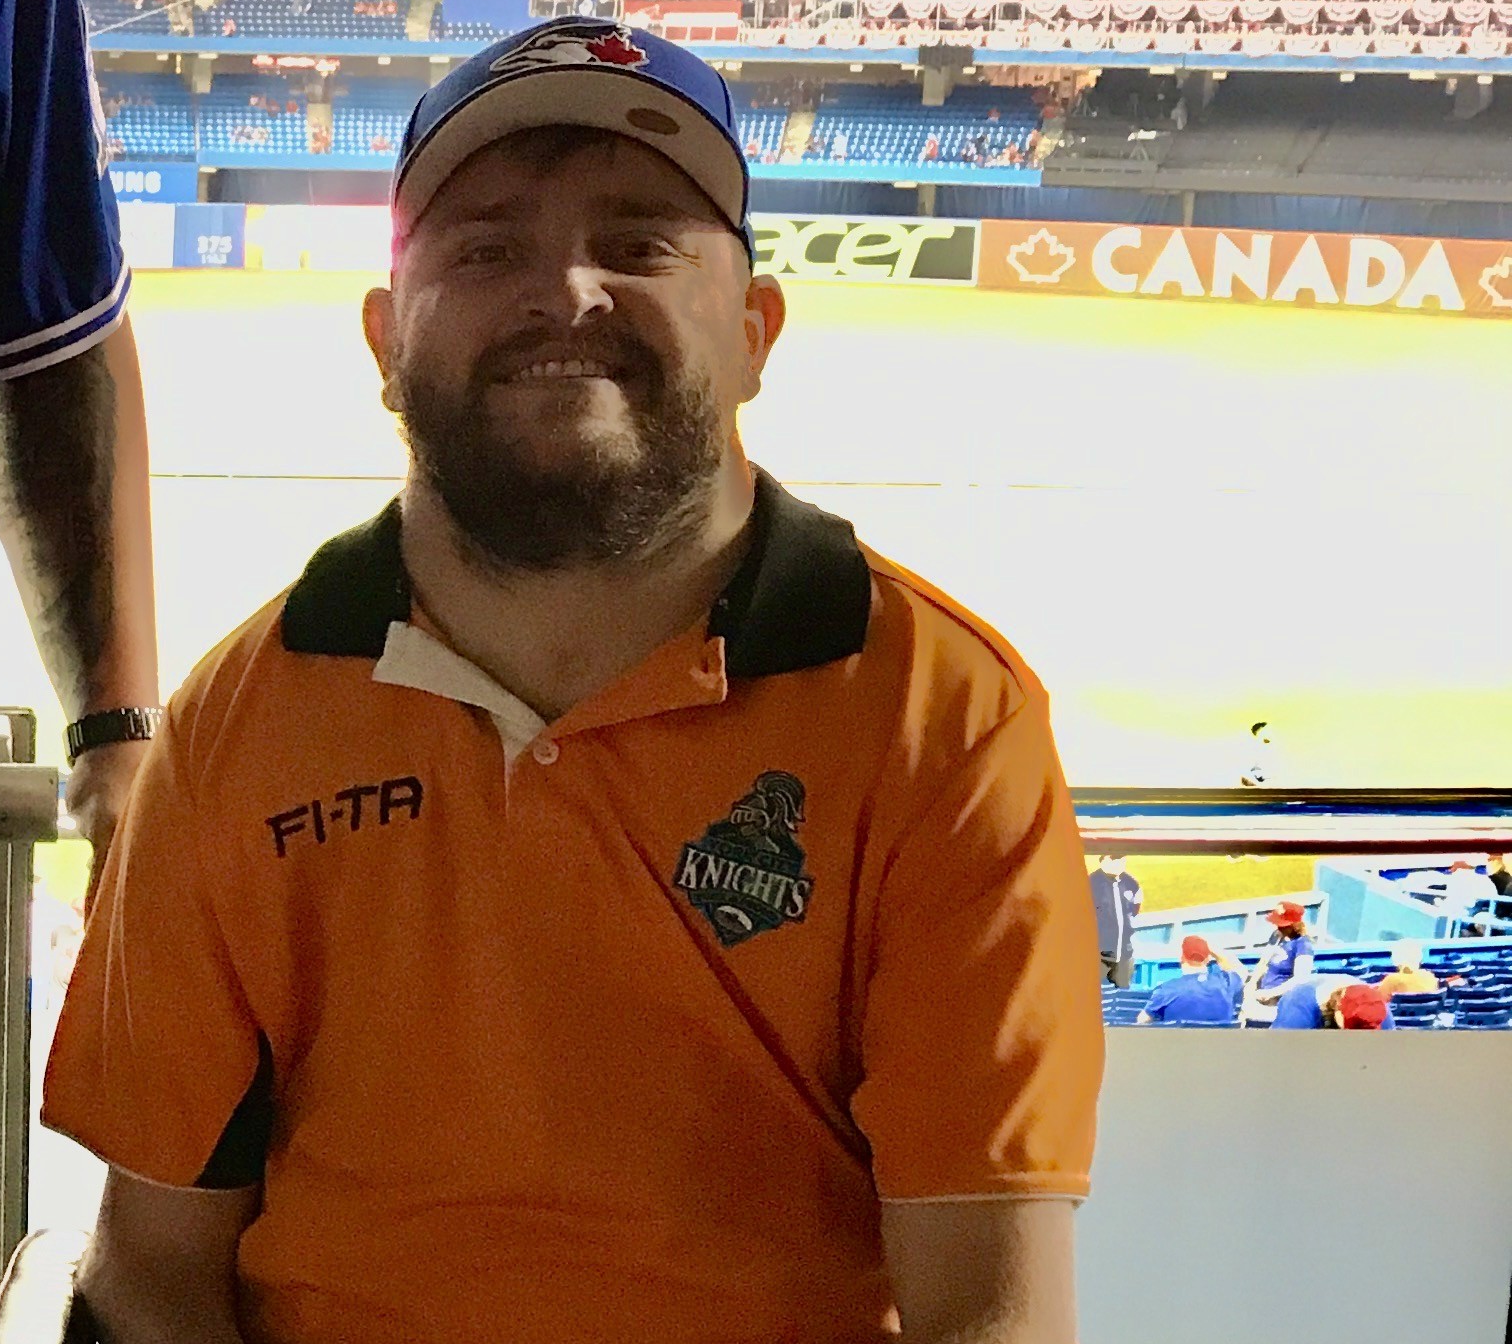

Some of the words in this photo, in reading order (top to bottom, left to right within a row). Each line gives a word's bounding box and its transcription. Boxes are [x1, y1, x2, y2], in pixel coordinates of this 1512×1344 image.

[754, 218, 955, 281] acer
[1091, 226, 1465, 311] CANADA
[677, 847, 810, 918] KNIGHTS
